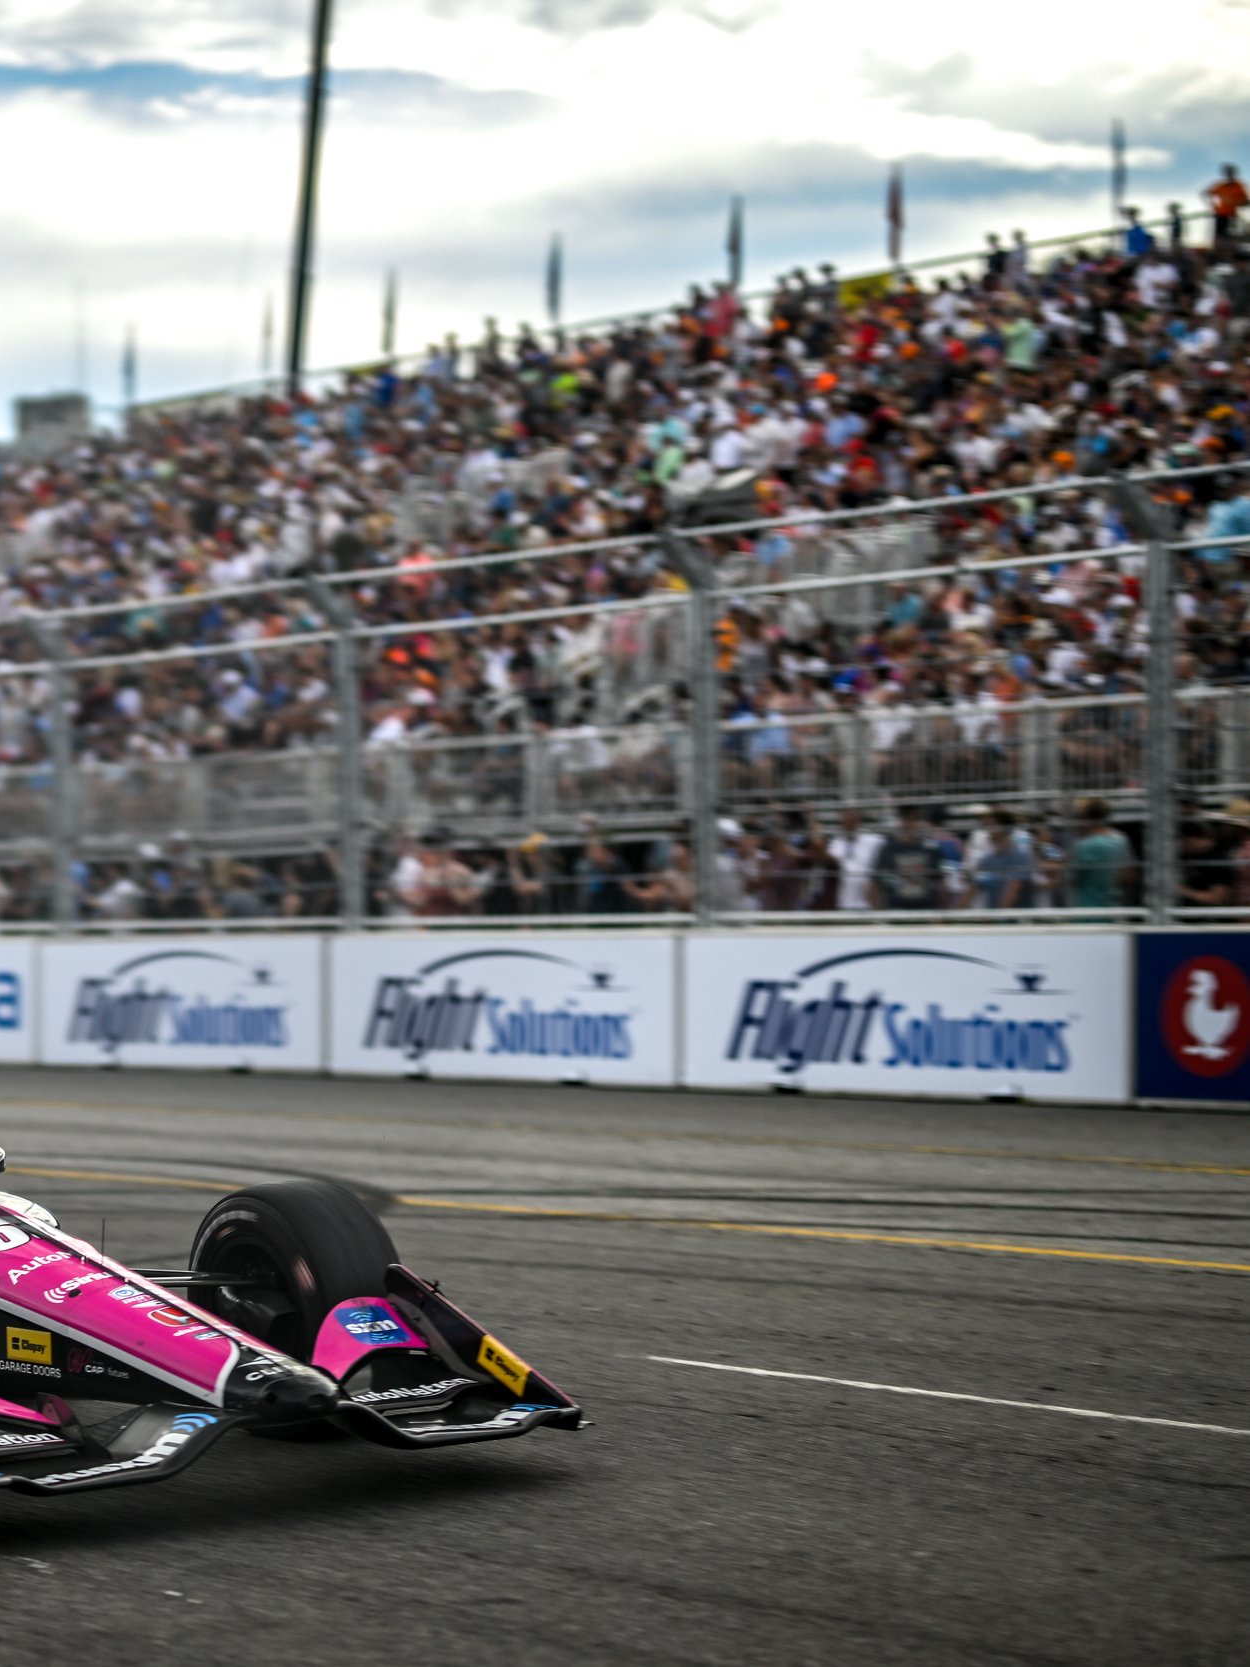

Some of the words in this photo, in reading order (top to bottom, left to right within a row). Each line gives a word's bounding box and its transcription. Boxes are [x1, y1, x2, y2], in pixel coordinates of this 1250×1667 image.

[65, 977, 174, 1052] Flight
[168, 995, 289, 1047] Solutions
[362, 976, 487, 1060] Flight
[487, 997, 633, 1059] Solutions
[725, 980, 880, 1071] Flight
[883, 1003, 1070, 1071] Solutions
[0, 1360, 32, 1374] GARAGE
[33, 1365, 62, 1378] DOORS
[21, 1339, 47, 1354] Clopay
